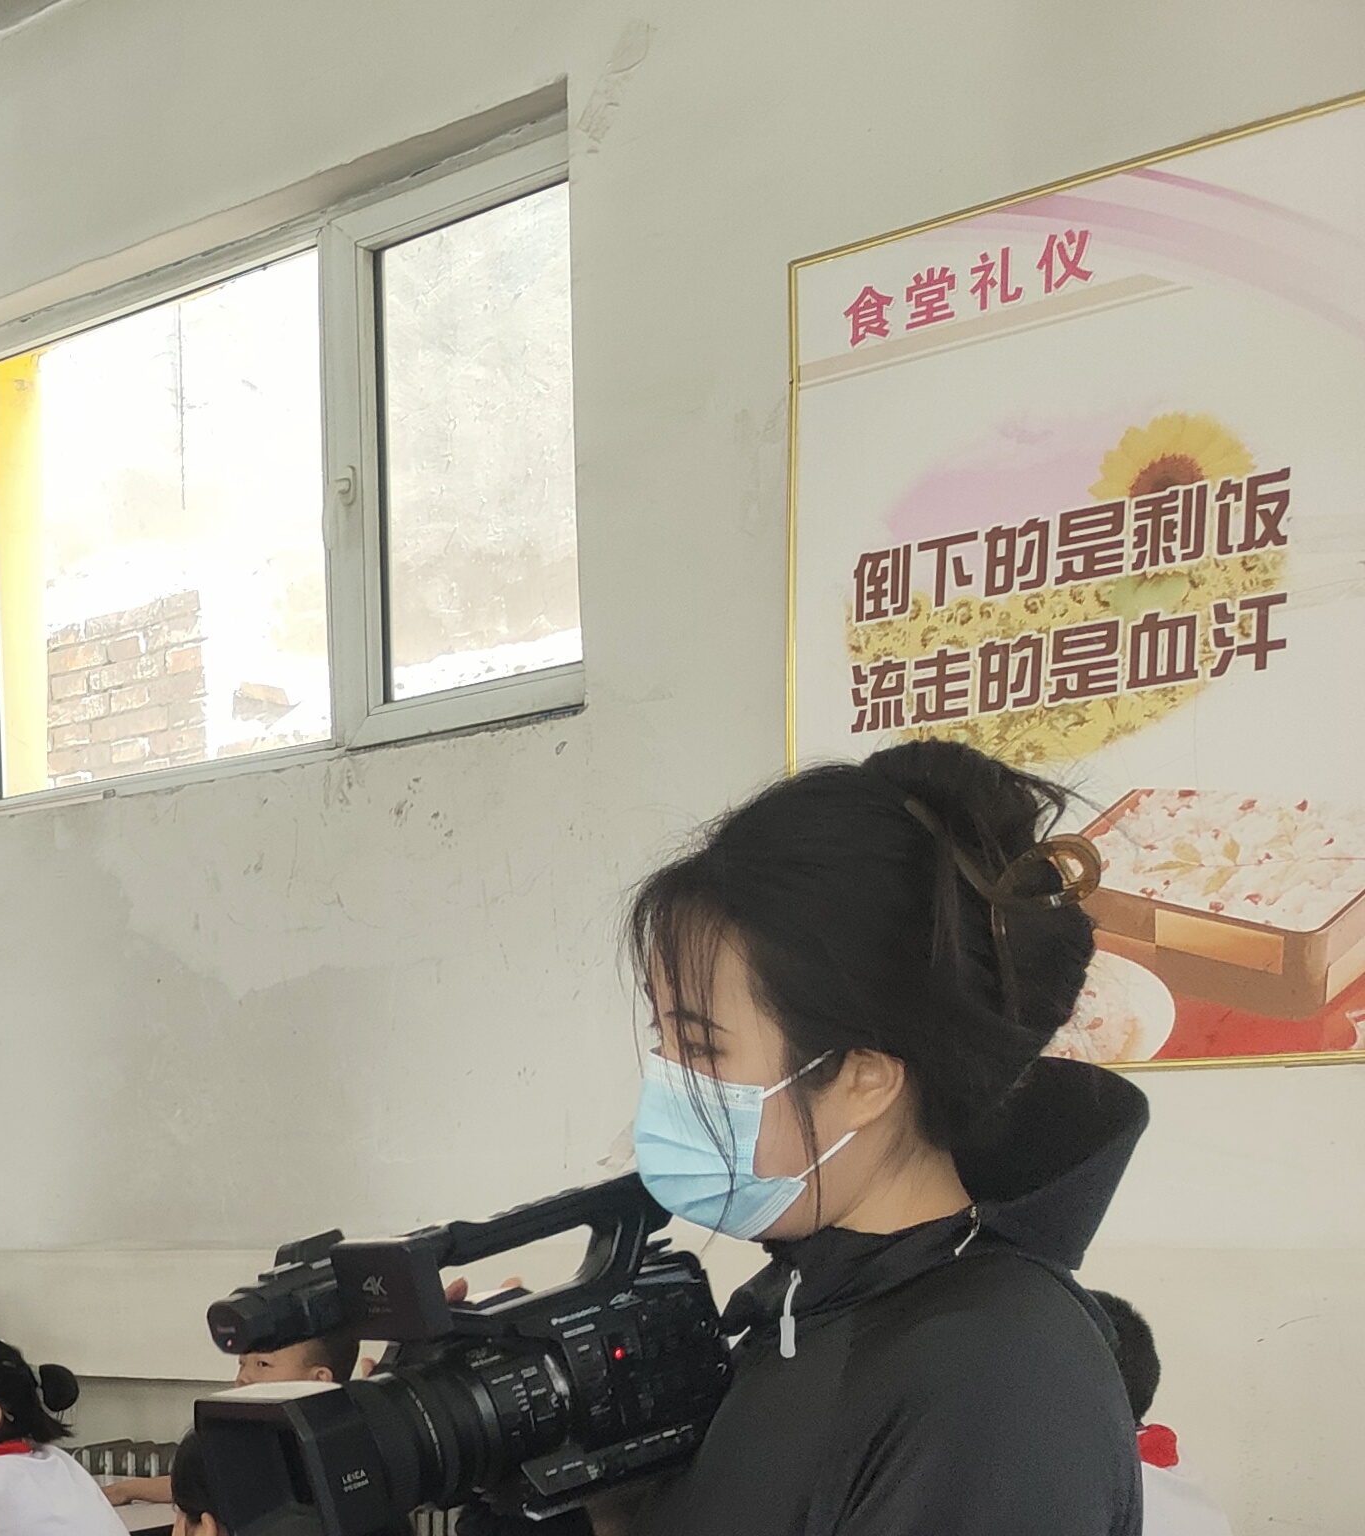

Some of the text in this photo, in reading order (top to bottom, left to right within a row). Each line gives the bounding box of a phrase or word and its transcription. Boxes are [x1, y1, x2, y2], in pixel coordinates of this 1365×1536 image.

[843, 228, 1094, 347] 食堂礼仪
[852, 466, 1291, 623] 倒下的是剩饭
[850, 592, 1288, 733] 流走的是血汗
[362, 1275, 388, 1296] 4K
